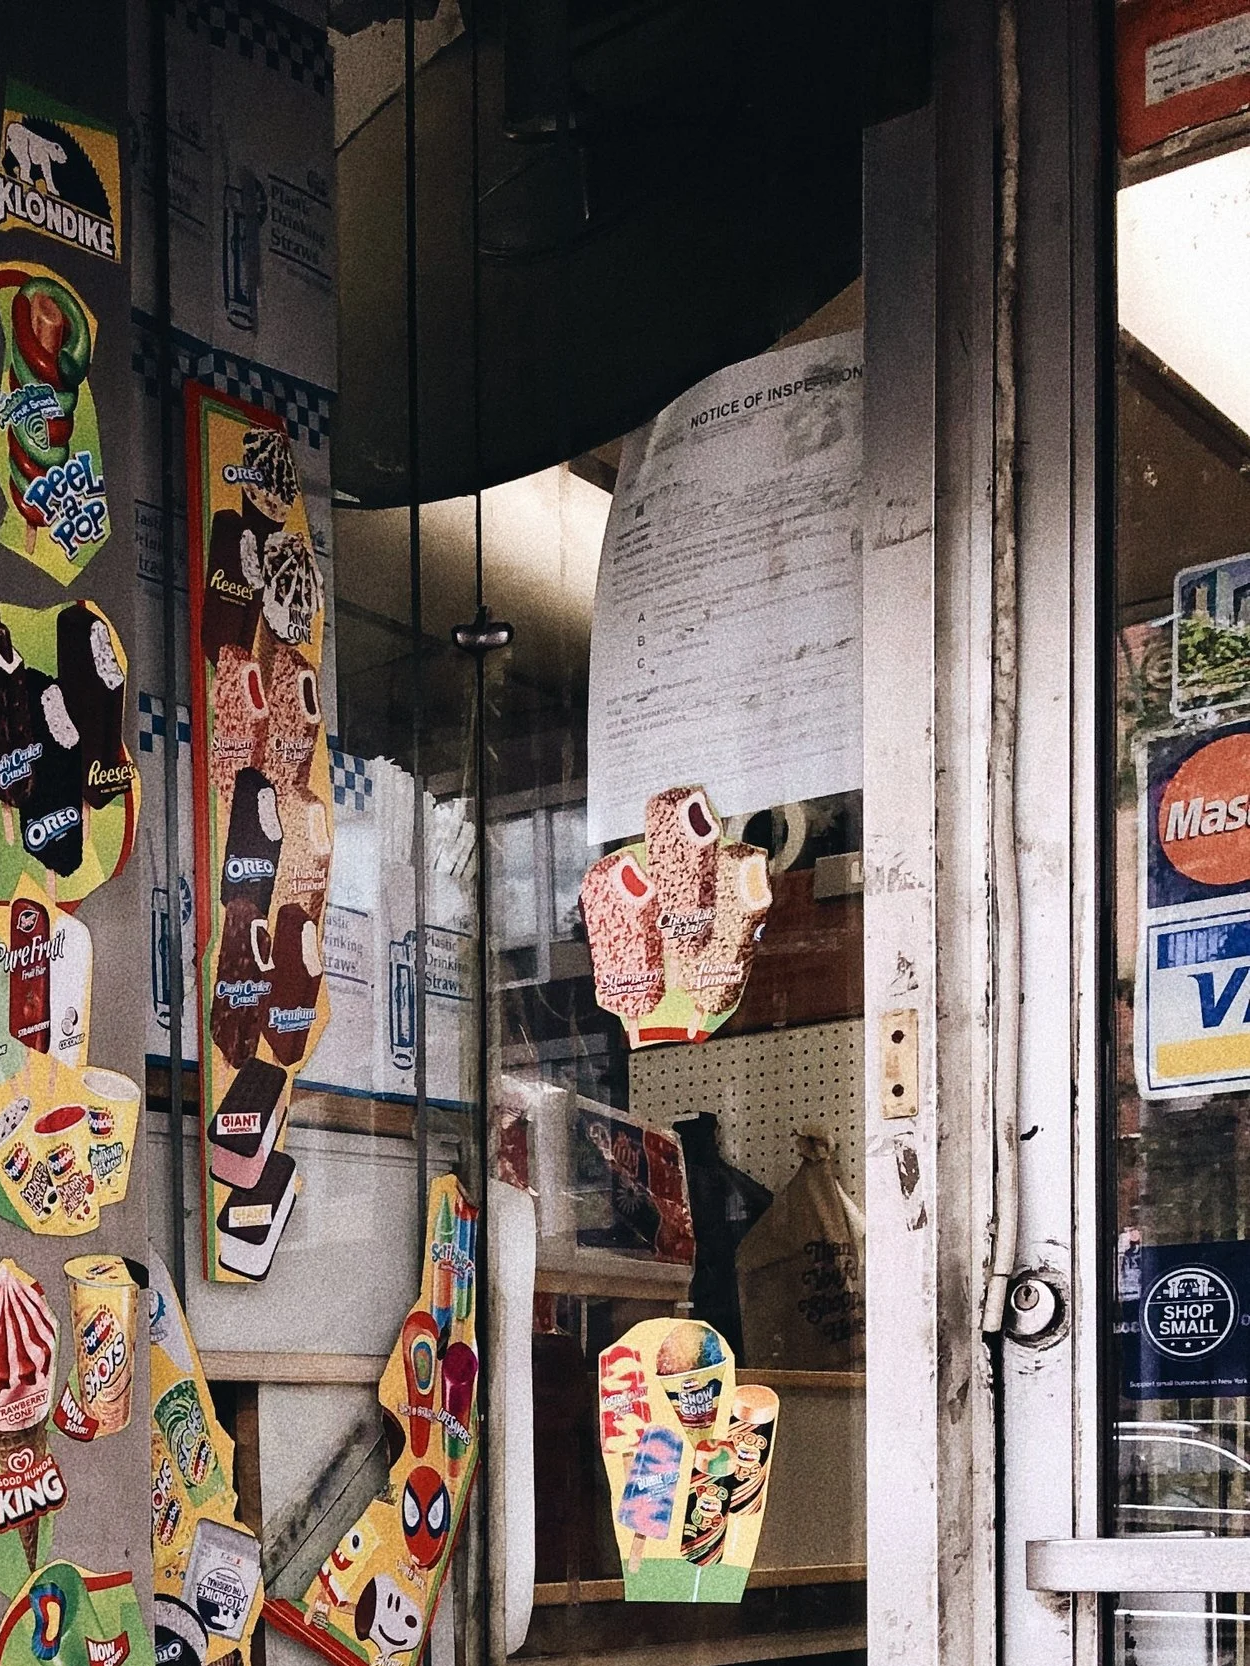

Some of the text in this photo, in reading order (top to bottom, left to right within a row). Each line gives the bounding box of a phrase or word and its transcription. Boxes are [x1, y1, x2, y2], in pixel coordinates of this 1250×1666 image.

[690, 399, 740, 429] NOTICE
[743, 391, 764, 409] OF
[223, 464, 263, 483] OREO
[53, 501, 107, 558] POP
[210, 568, 253, 601] Reese's
[287, 625, 313, 646] CONE
[88, 760, 136, 787] Reese's
[25, 807, 80, 850] OREO
[226, 857, 276, 880] OREO
[657, 909, 717, 929] Chocolate
[698, 960, 746, 975] Toasted
[694, 972, 743, 990] Almond
[268, 1007, 318, 1026] Premium
[221, 1114, 259, 1128] GIANT
[1163, 1303, 1215, 1320] SHOP
[1159, 1318, 1219, 1336] SMALL
[82, 1335, 127, 1403] SHOTS
[1129, 1380, 1156, 1388] Support
[1233, 1377, 1248, 1385] York
[680, 1387, 714, 1407] SNOW
[7, 1406, 35, 1424] CONE
[61, 1392, 87, 1427] NOW
[680, 1401, 713, 1418] CONE
[732, 1433, 767, 1451] POP
[24, 1456, 54, 1481] HUMOR
[695, 1485, 729, 1502] POP
[691, 1508, 725, 1531] UPS
[198, 1586, 248, 1612] KLONDIKE
[87, 1640, 116, 1662] NOW
